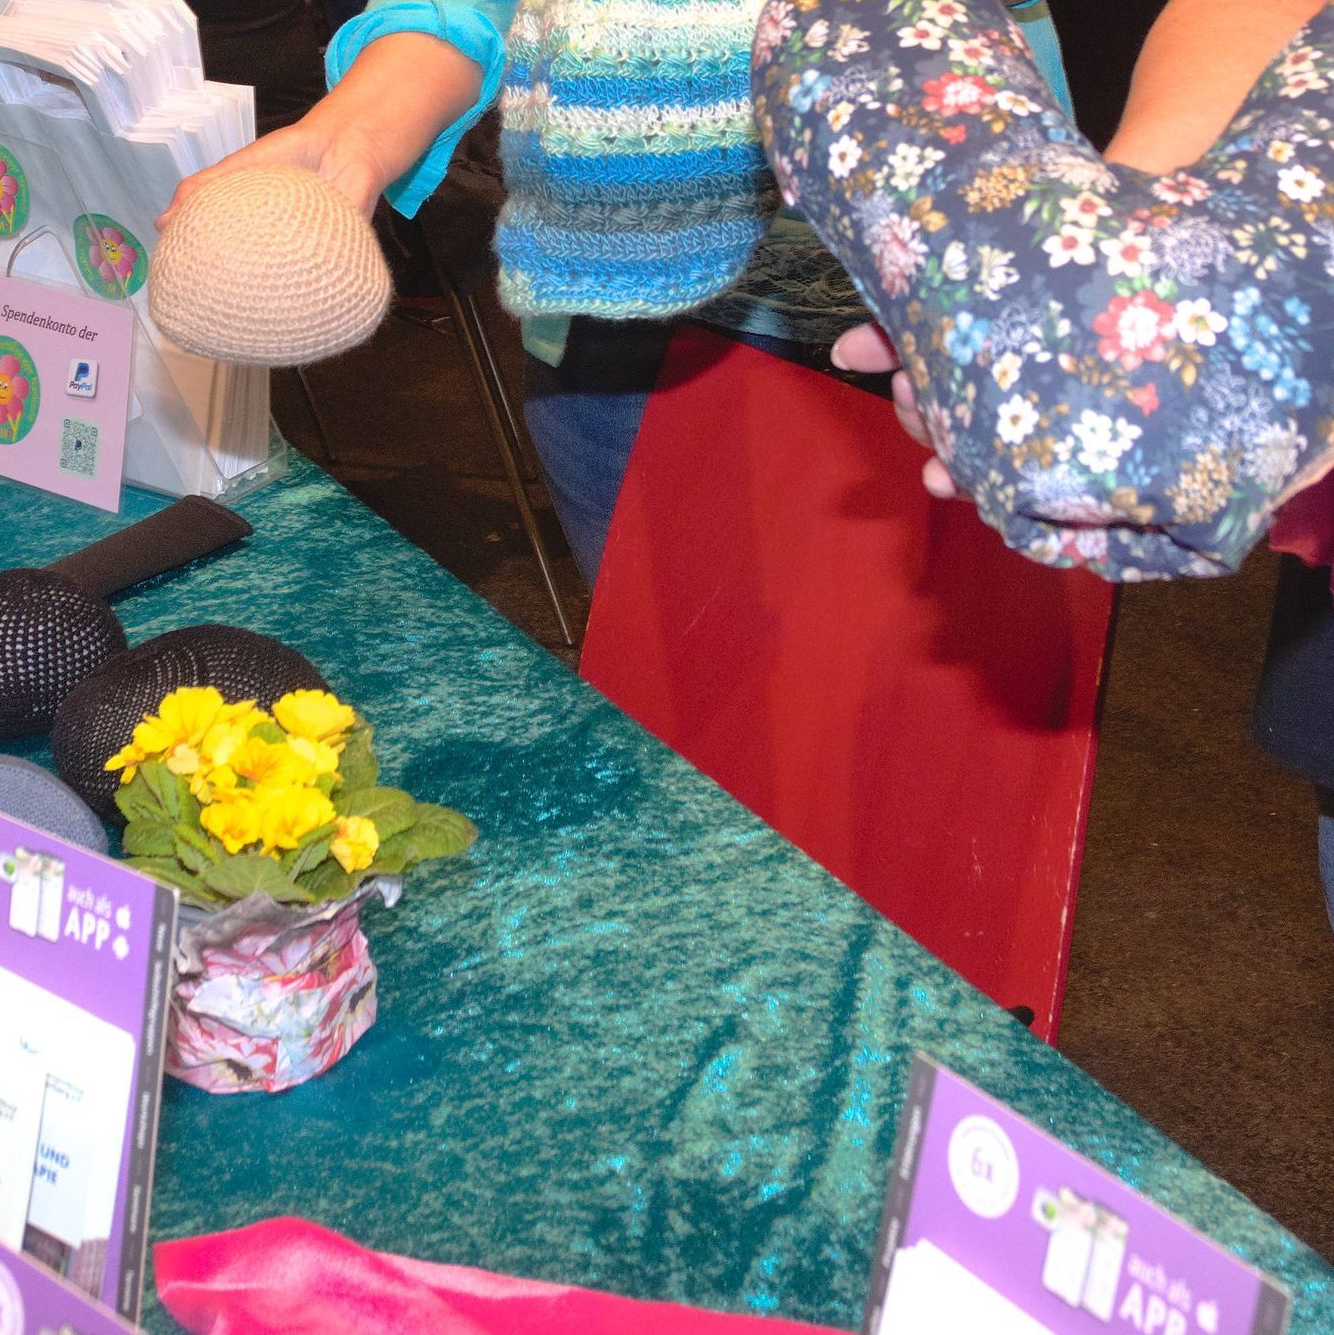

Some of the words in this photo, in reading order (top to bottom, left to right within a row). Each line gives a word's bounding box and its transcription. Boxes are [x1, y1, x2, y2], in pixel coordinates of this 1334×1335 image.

[1, 304, 77, 337] Spendenkonto
[78, 326, 99, 342] der
[68, 380, 93, 392] PayPal
[66, 883, 94, 910] auch
[63, 907, 112, 951] APP
[40, 1144, 71, 1170] UND
